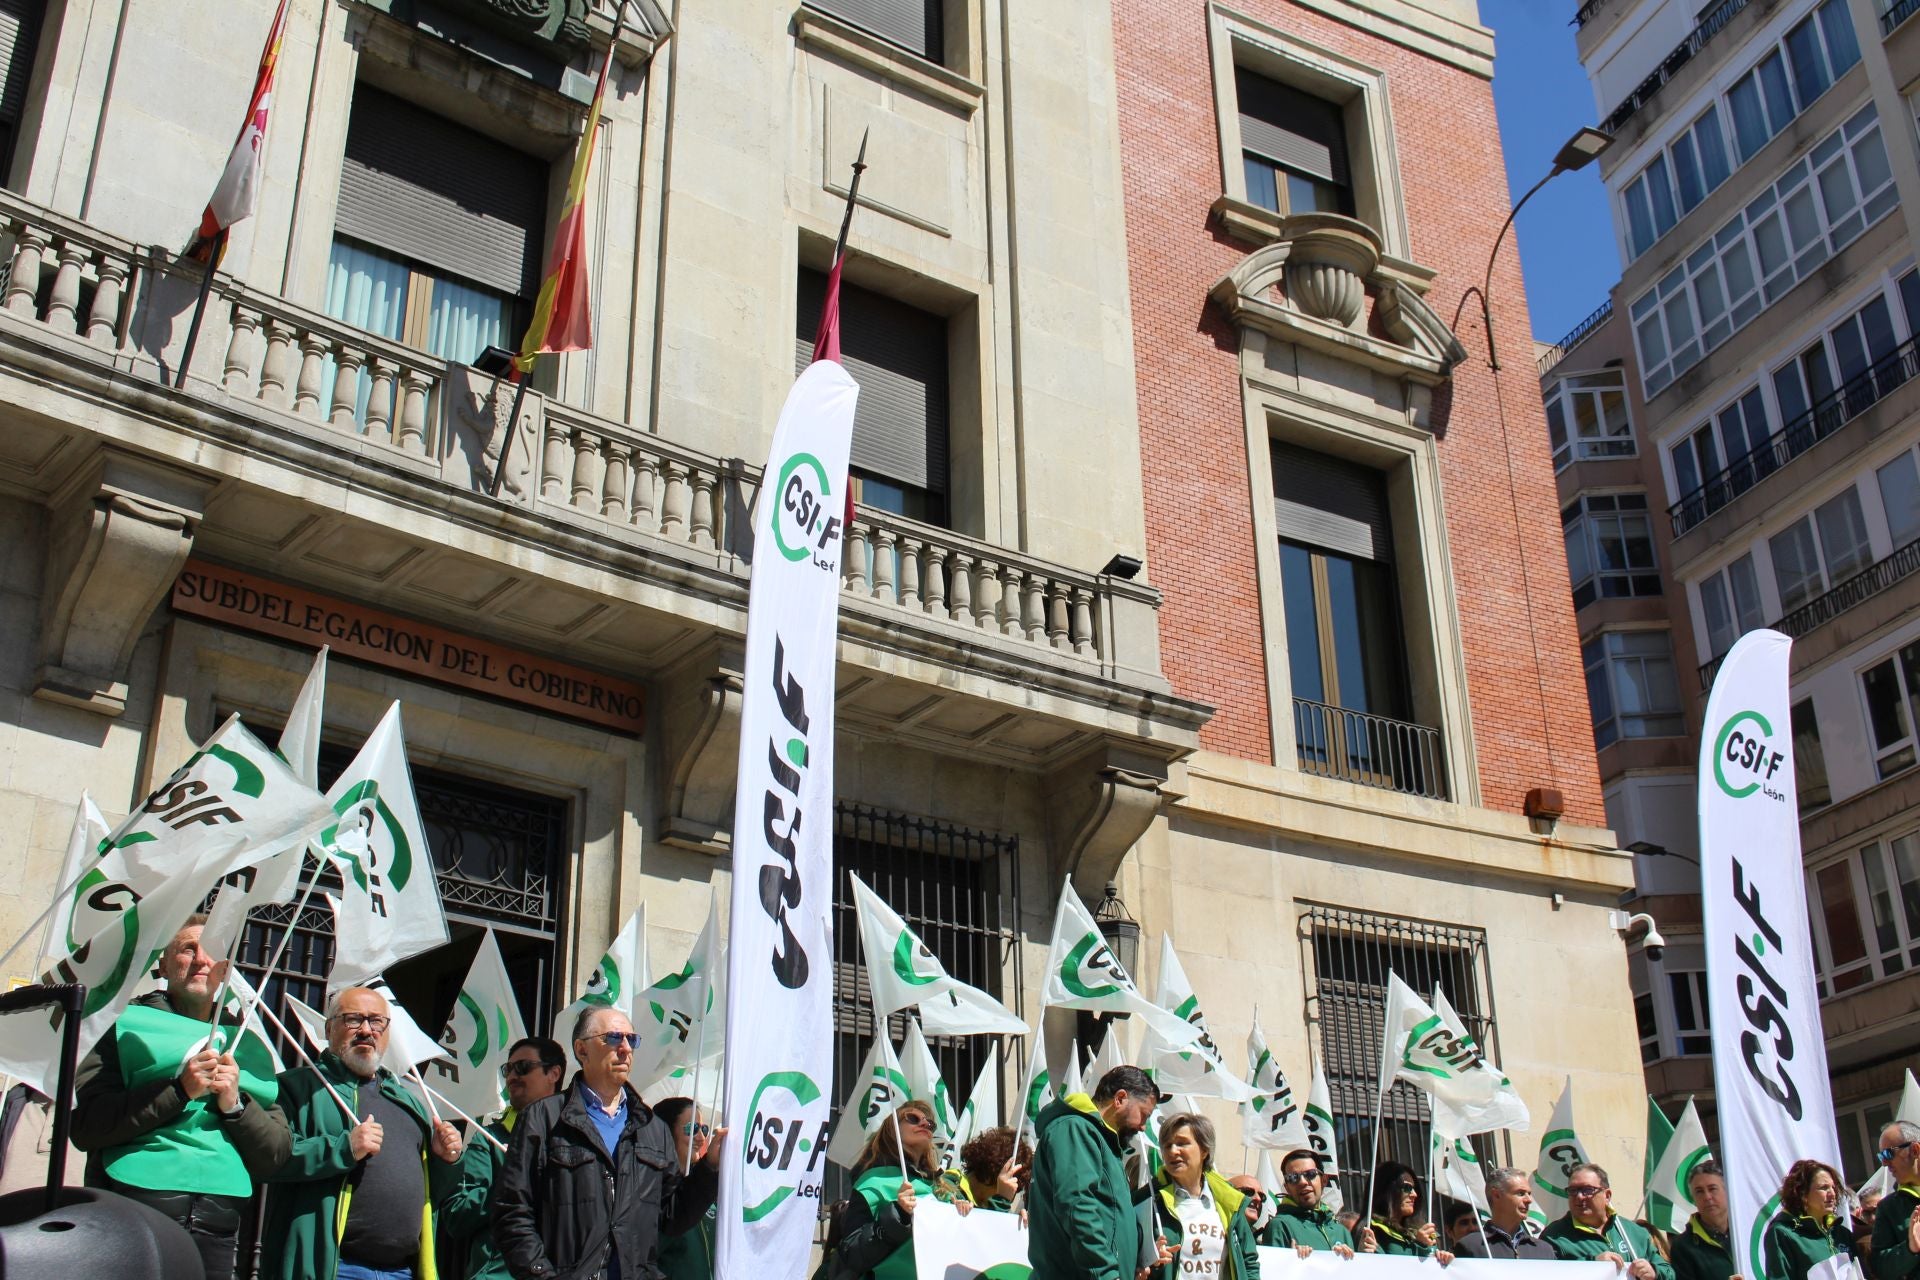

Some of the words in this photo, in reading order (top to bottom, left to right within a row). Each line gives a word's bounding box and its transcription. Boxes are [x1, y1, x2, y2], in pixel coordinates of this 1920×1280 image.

[178, 571, 432, 664] SUBDELEGACION
[441, 644, 498, 682] DEL
[508, 664, 643, 721] GOBIERNO
[1763, 783, 1785, 803] León
[1191, 1238, 1203, 1256] &
[1180, 1260, 1222, 1274] OAST
